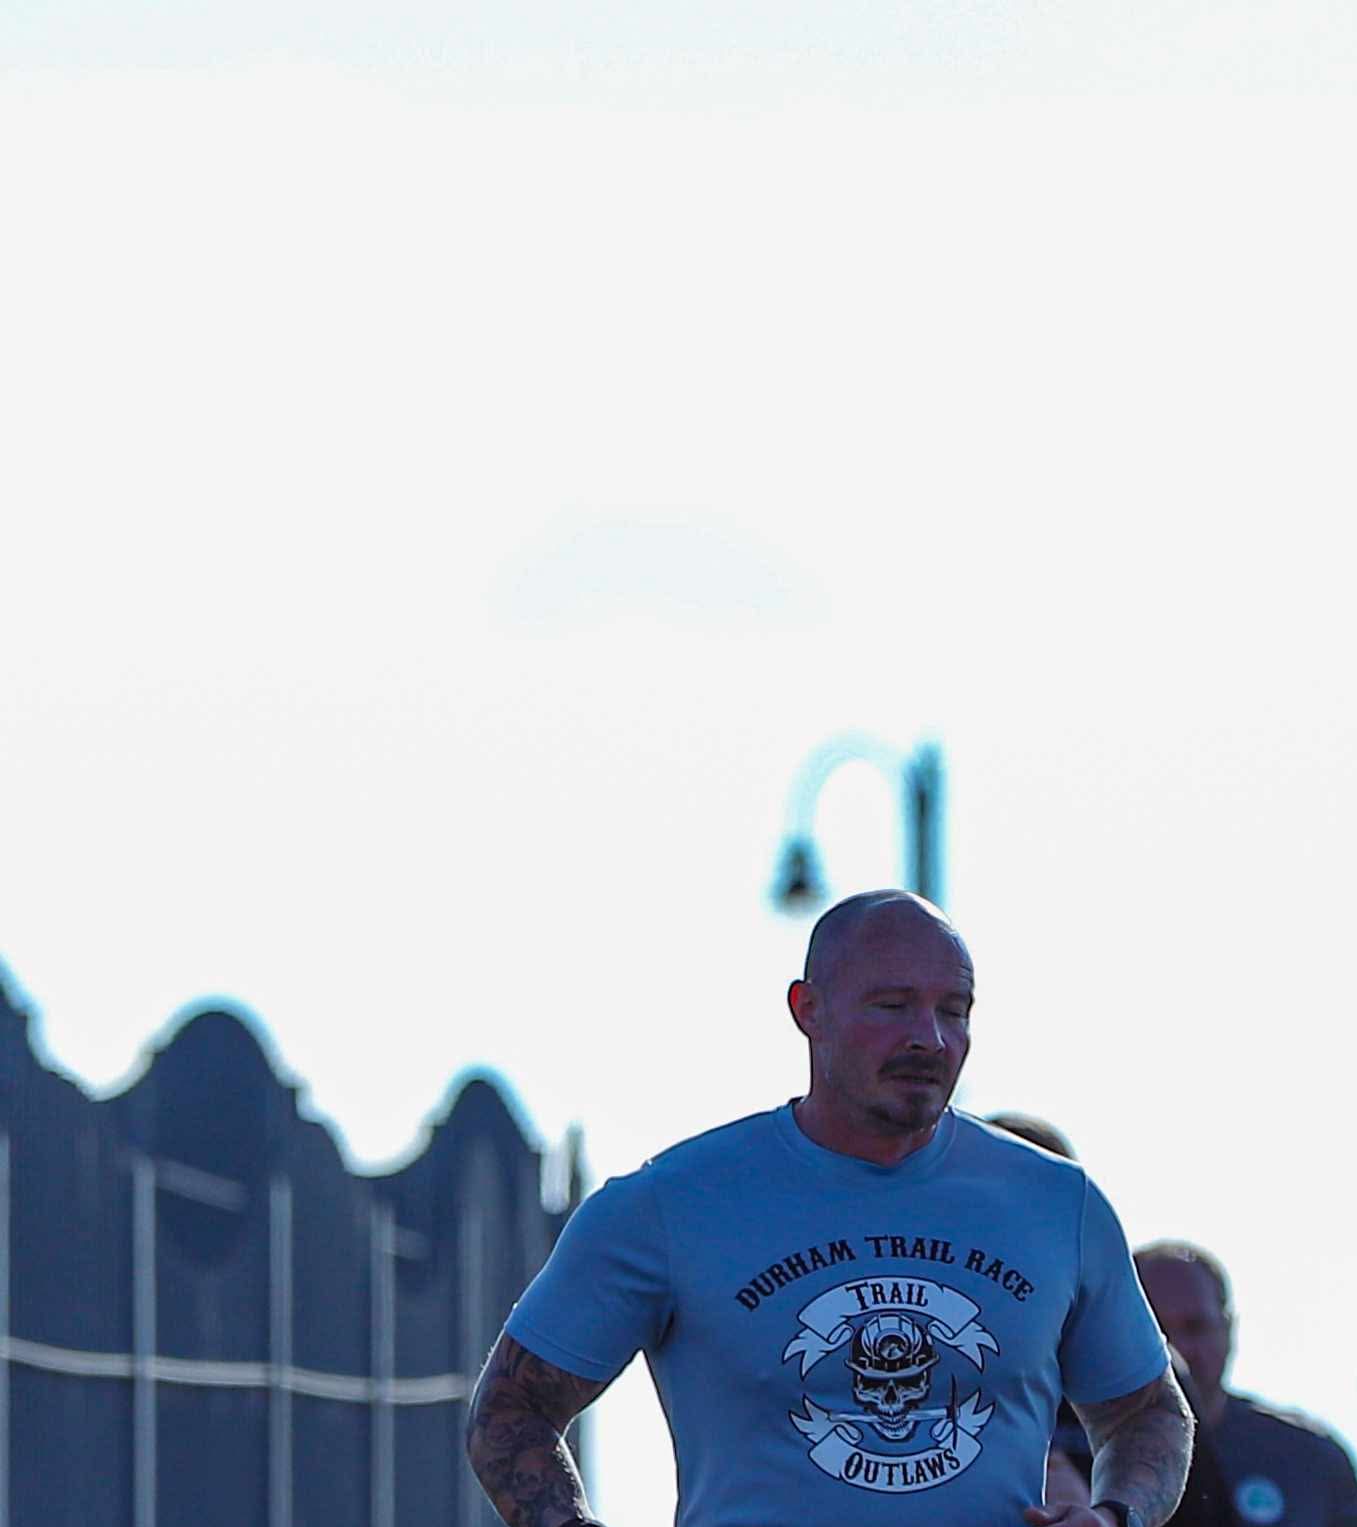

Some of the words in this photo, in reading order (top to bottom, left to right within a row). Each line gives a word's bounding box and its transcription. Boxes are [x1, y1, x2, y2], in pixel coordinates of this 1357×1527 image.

[735, 1239, 857, 1312] DURHAM
[864, 1234, 956, 1265] TRAIL
[963, 1248, 1035, 1303] RACE
[845, 1281, 929, 1311] TRAIL
[844, 1448, 961, 1487] OUTLAWS
